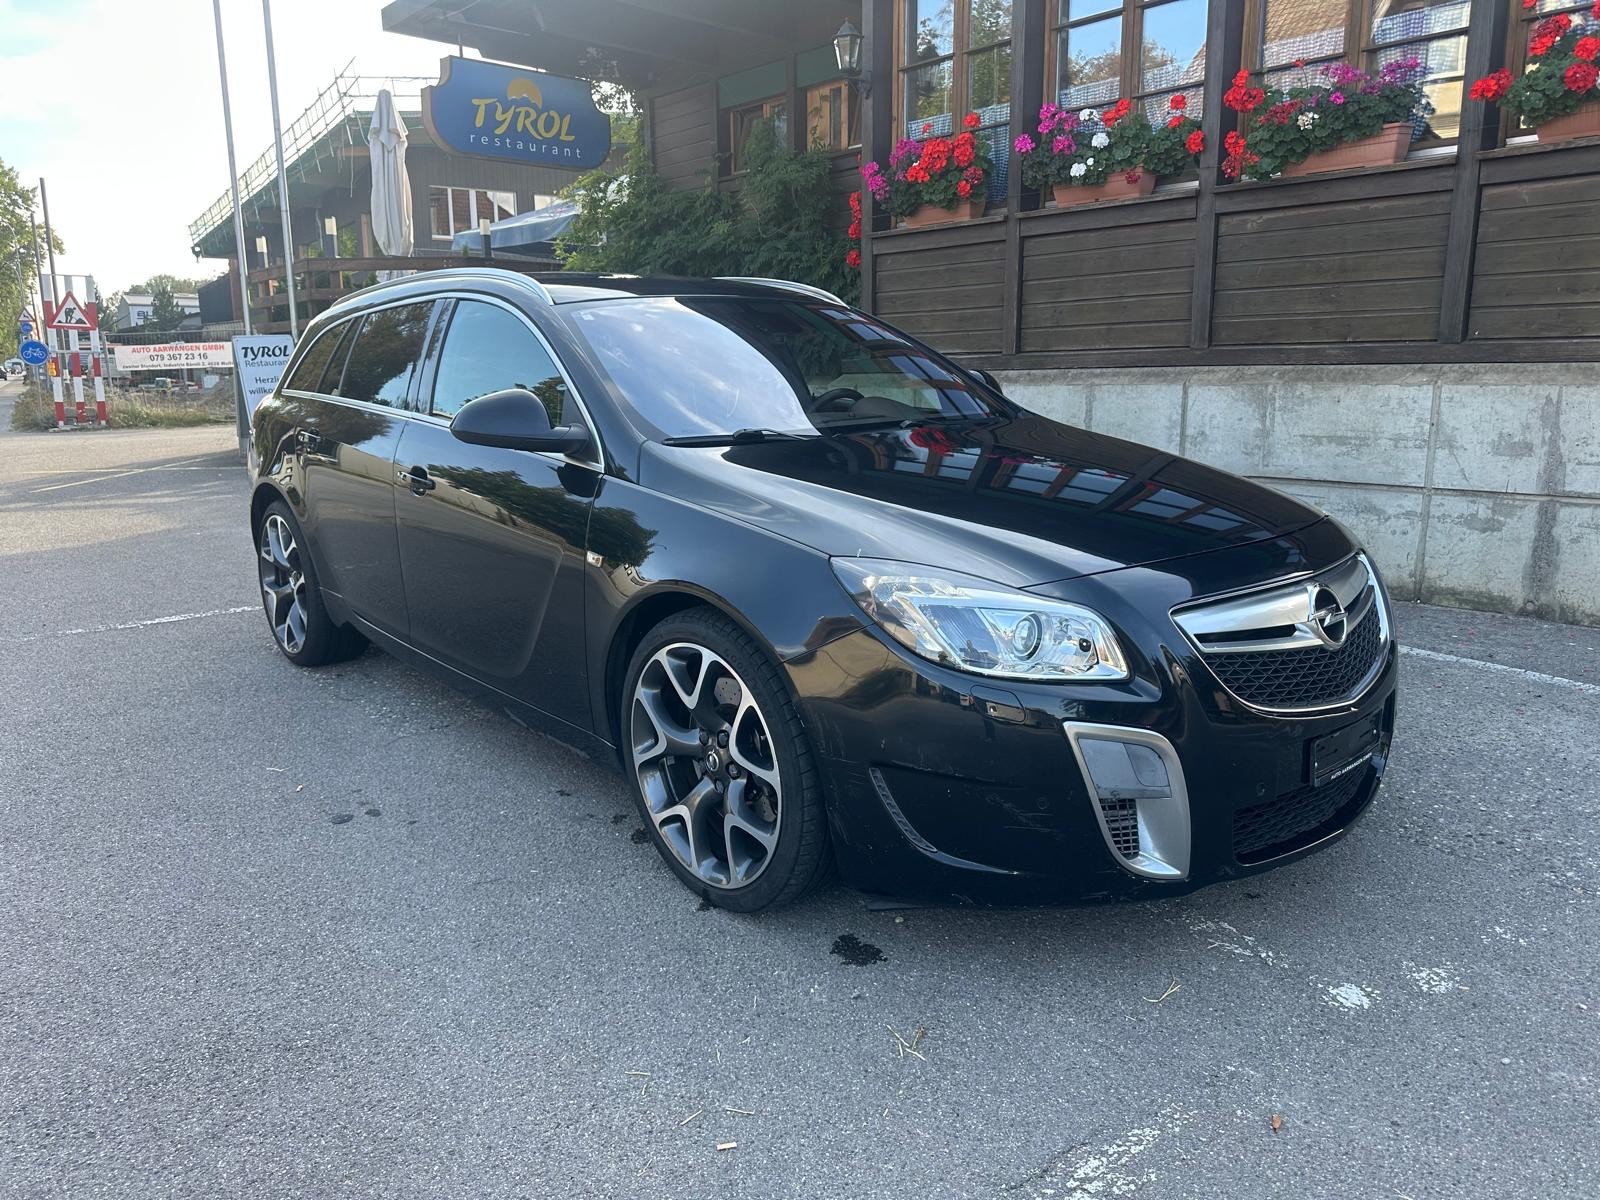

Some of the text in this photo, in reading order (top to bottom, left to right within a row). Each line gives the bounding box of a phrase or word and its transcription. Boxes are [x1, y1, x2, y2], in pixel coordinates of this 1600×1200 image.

[471, 98, 576, 141] TYROL
[469, 134, 581, 158] restaurant
[152, 344, 200, 352] AARWANGEN
[241, 345, 290, 361] TYROL
[166, 353, 182, 361] 367
